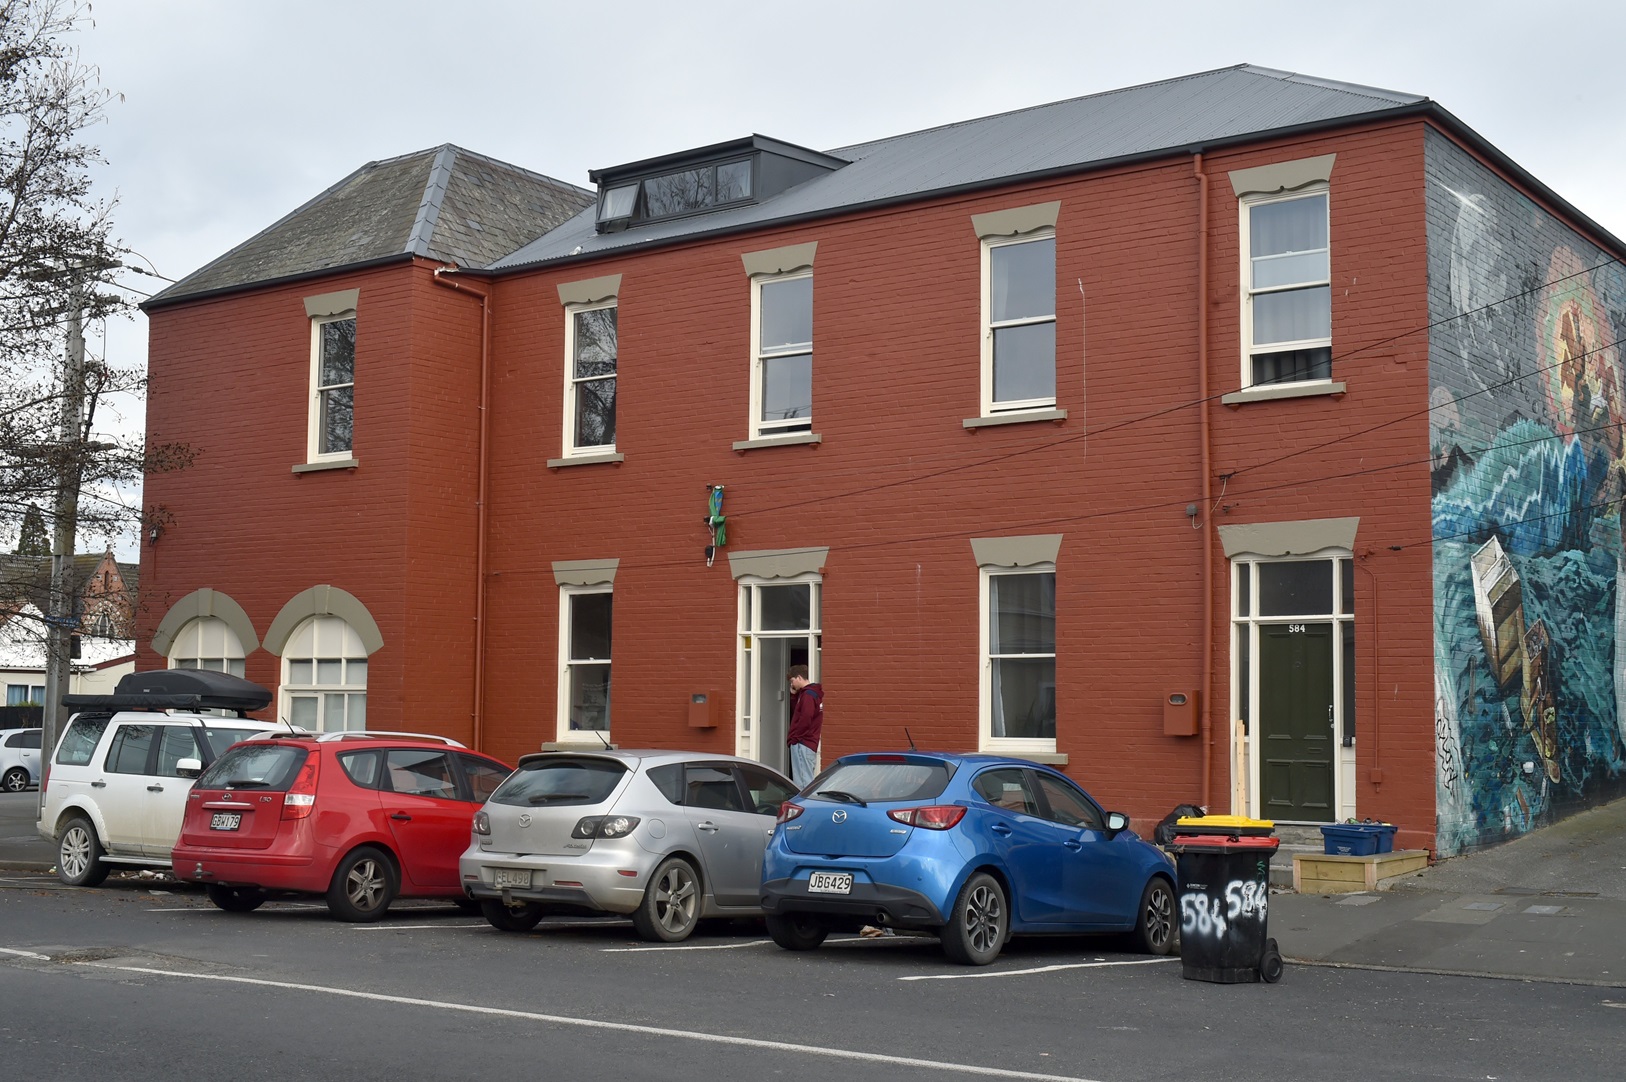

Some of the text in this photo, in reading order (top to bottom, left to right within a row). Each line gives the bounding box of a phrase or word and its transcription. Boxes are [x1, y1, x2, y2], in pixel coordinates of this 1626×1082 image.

[1289, 624, 1305, 633] 584
[810, 876, 851, 890] JBG429
[1224, 880, 1267, 922] 584
[1181, 893, 1227, 941] 584
